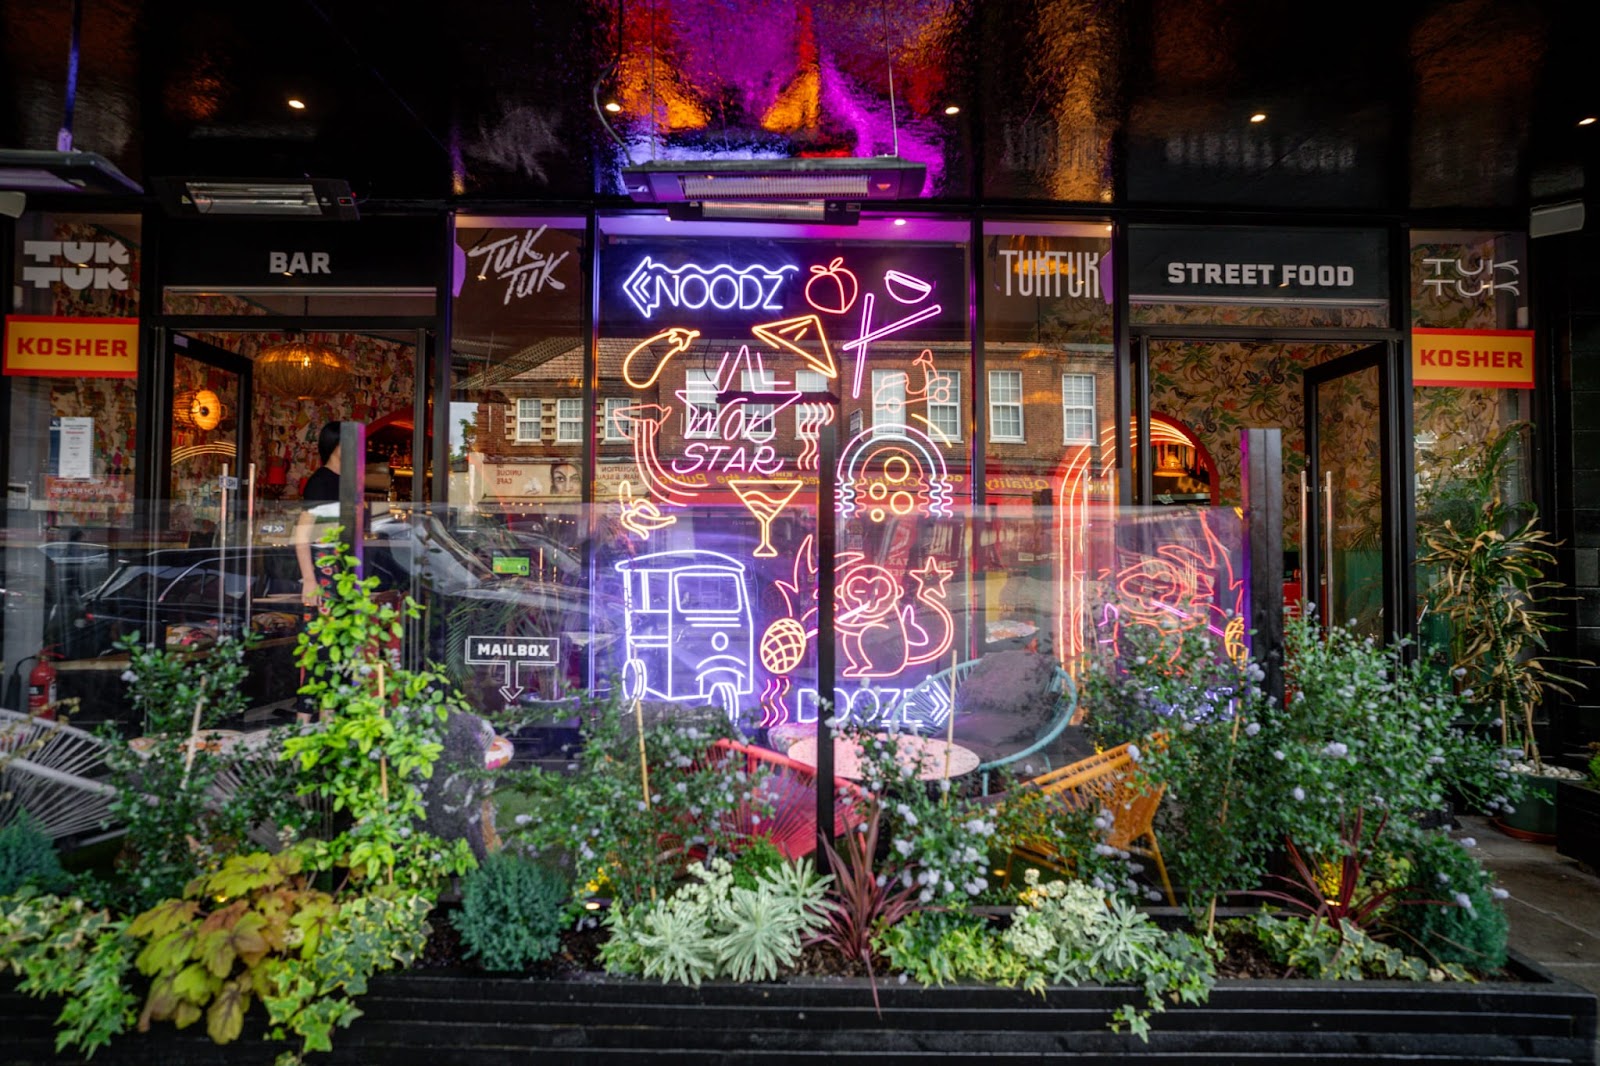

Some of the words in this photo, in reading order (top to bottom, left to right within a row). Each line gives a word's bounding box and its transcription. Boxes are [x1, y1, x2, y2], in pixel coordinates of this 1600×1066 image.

[23, 240, 129, 264] TUK
[269, 251, 332, 274] BAR
[468, 224, 547, 279] TUK
[23, 266, 129, 291] TUK
[497, 250, 570, 305] TUK
[998, 249, 1099, 298] TUKTUK
[1167, 262, 1275, 285] STREET
[1281, 264, 1355, 287] FOOD
[655, 273, 785, 310] NOODZ
[17, 337, 128, 357] KOSHER
[1420, 349, 1524, 368] KOSHER
[671, 442, 785, 475] STAR
[477, 643, 550, 657] MAILBOX
